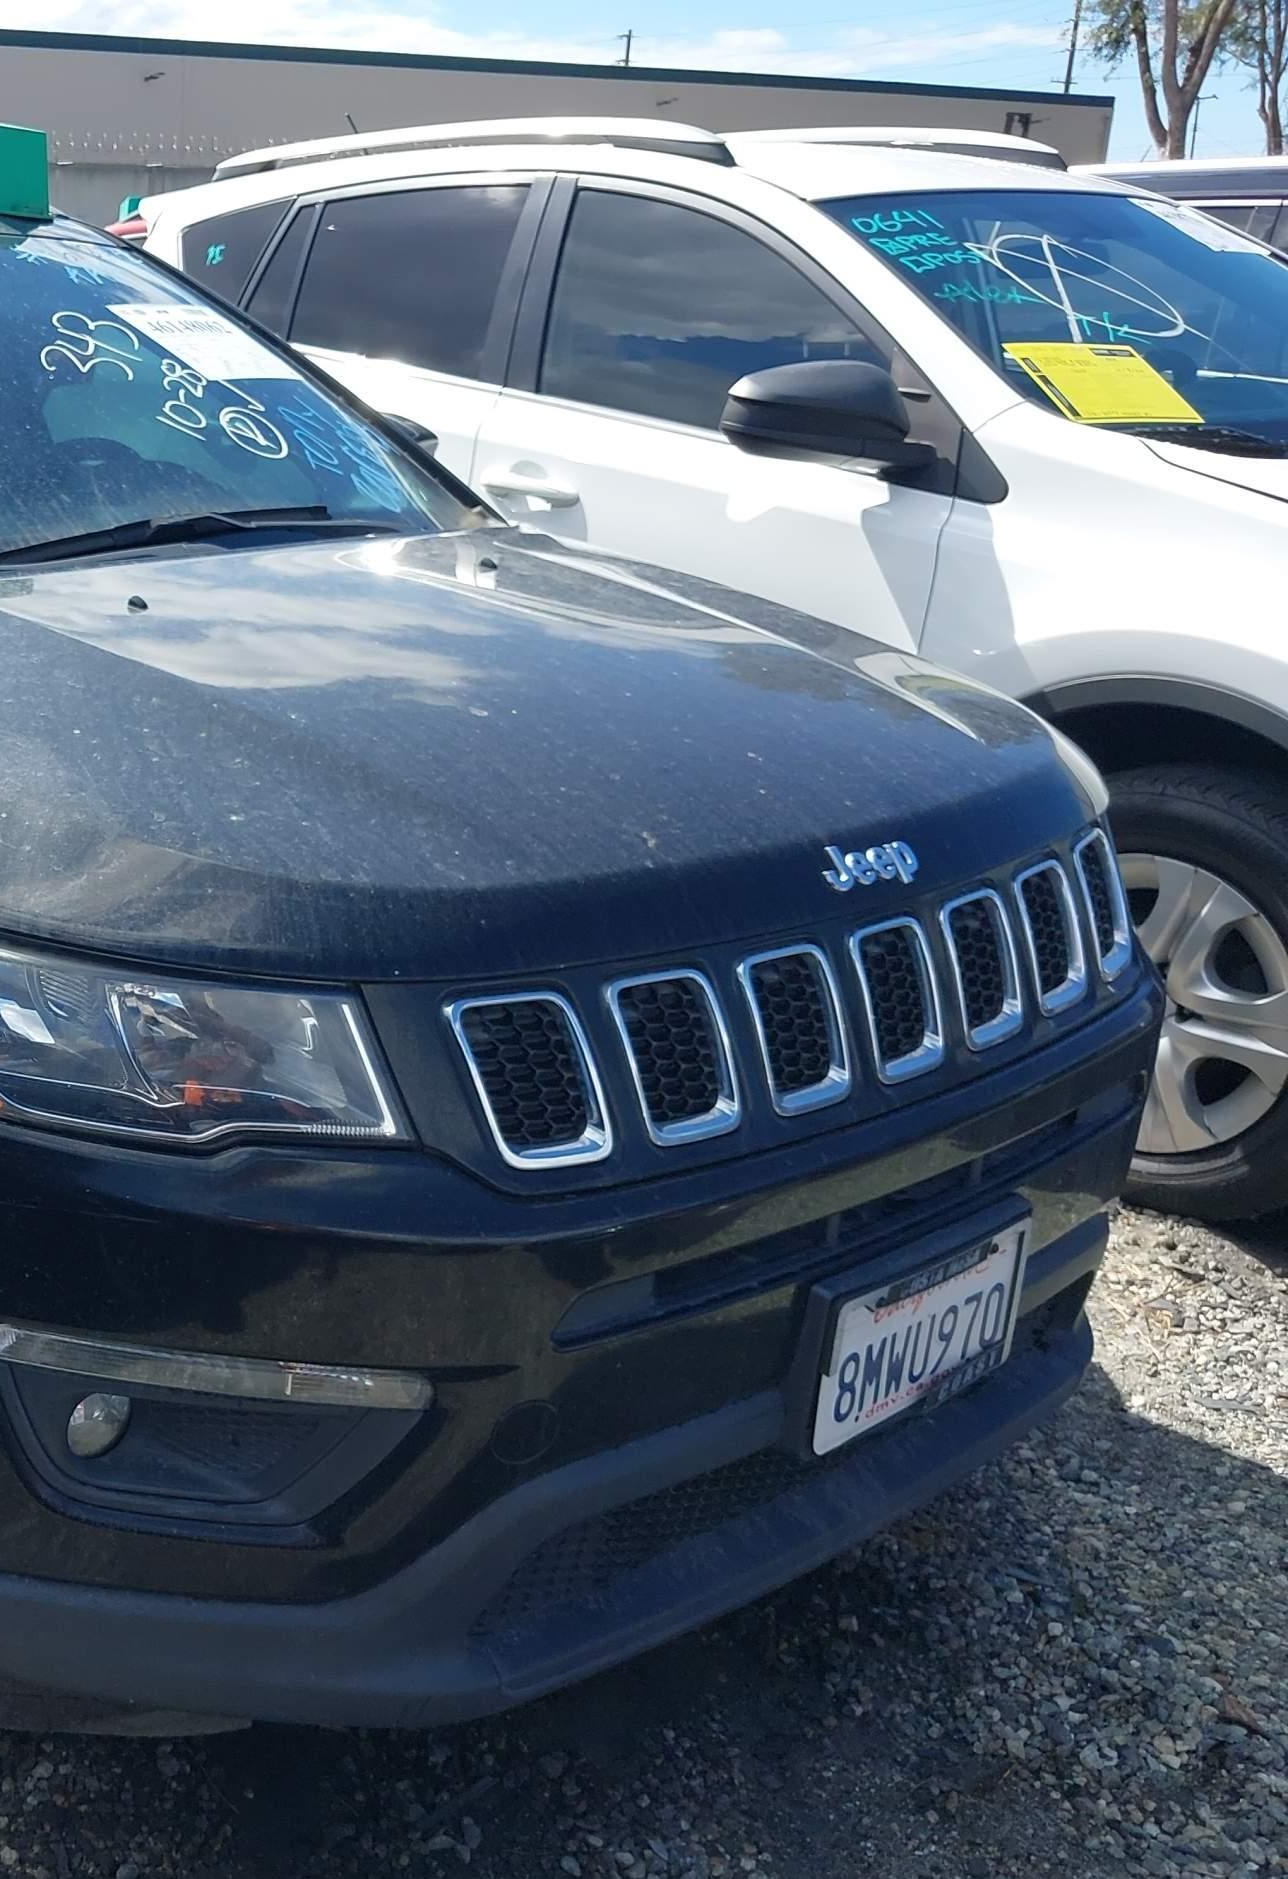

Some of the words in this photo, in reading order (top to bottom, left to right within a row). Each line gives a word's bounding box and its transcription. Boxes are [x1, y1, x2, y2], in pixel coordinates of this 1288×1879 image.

[156, 359, 208, 441] 10-28
[821, 841, 920, 892] Jeep
[833, 1282, 1005, 1423] 8MWU970
